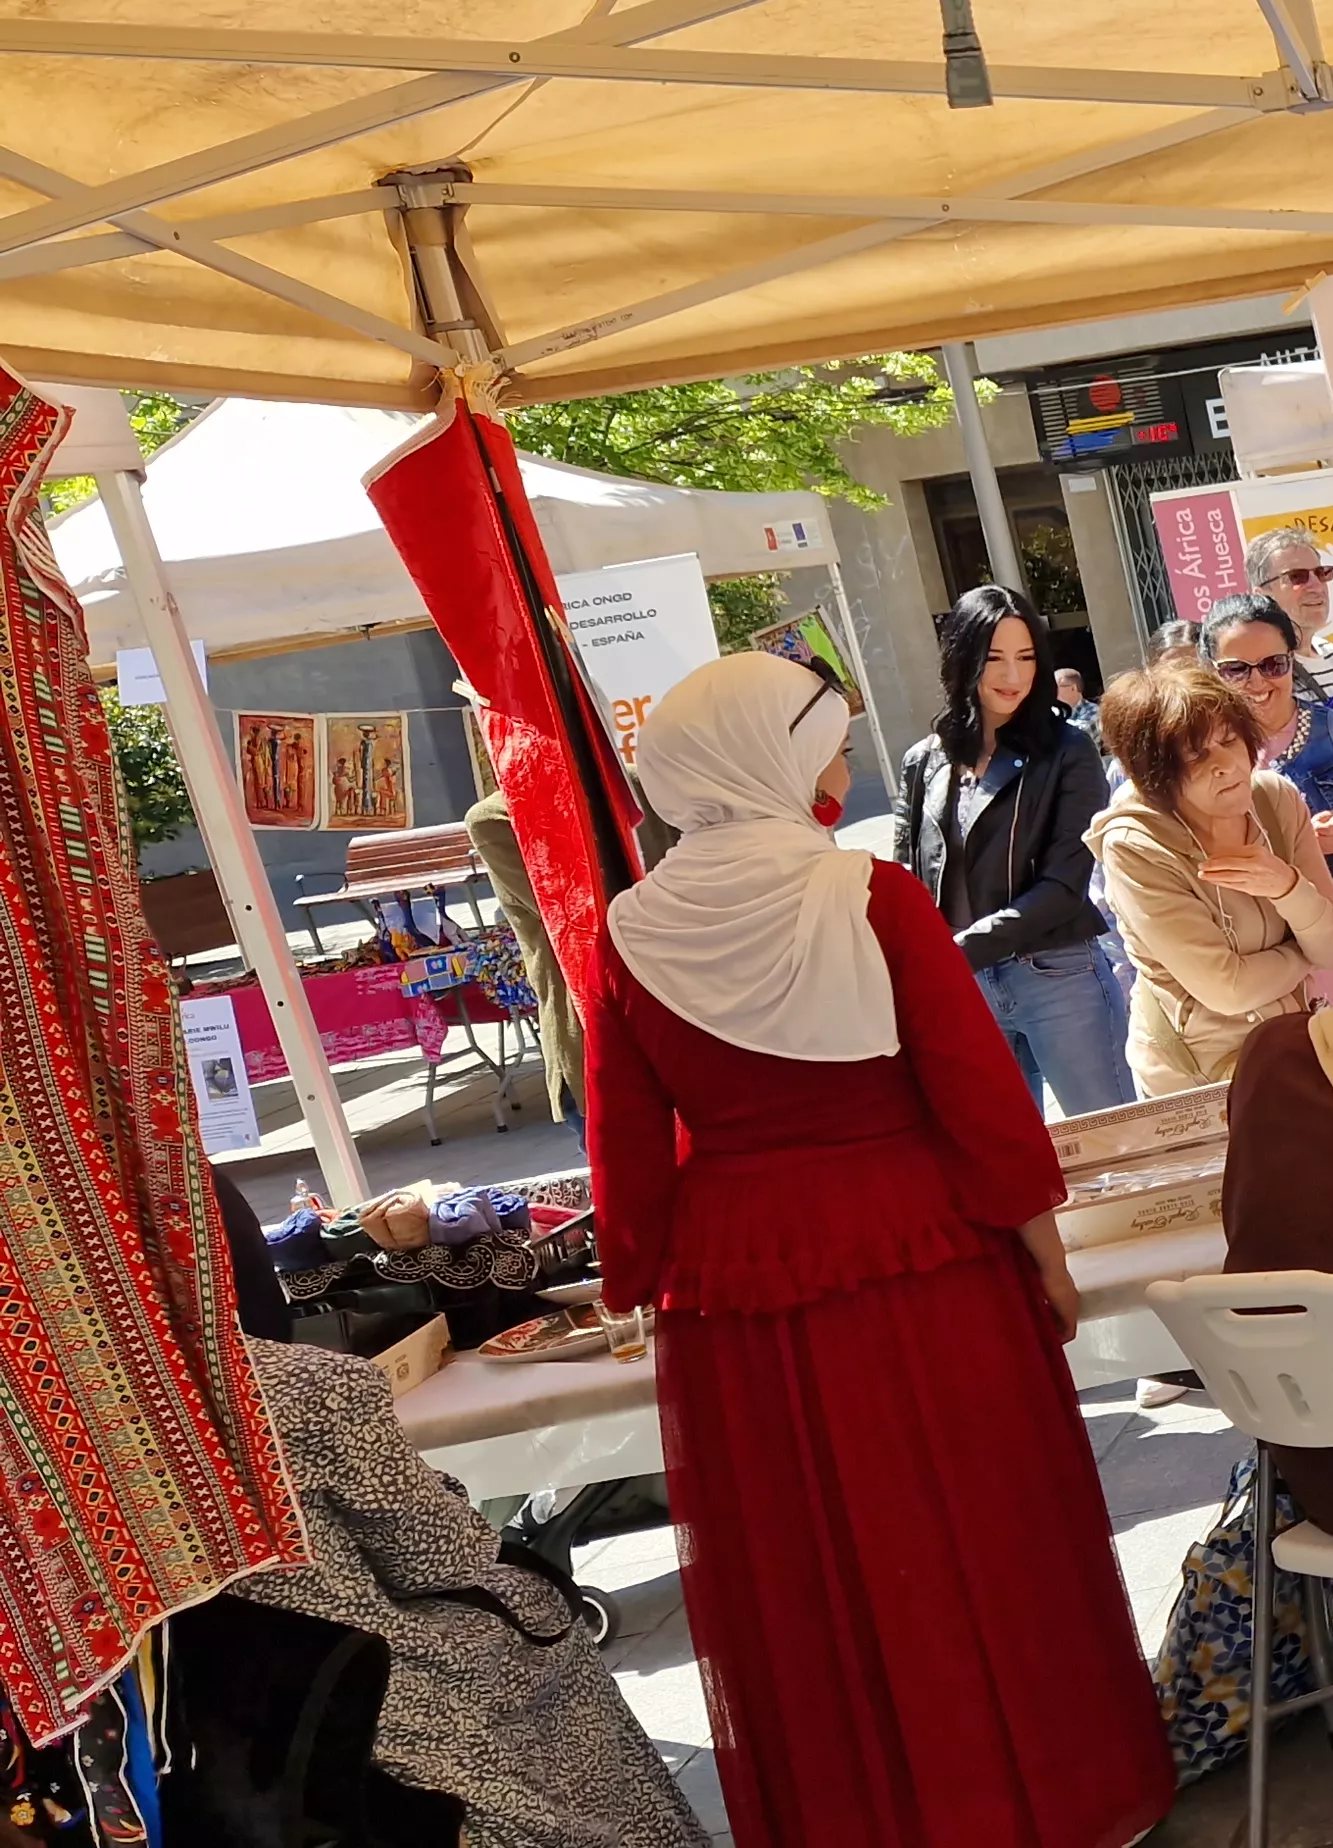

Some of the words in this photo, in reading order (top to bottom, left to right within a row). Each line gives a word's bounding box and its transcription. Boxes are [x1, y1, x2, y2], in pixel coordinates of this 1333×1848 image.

[1174, 507, 1207, 580] África
[1208, 508, 1237, 590] Huesca
[592, 592, 632, 606] ONGD
[1194, 584, 1212, 624] os
[569, 608, 657, 631] DESARROLLO
[591, 630, 645, 647] ESPAÑA
